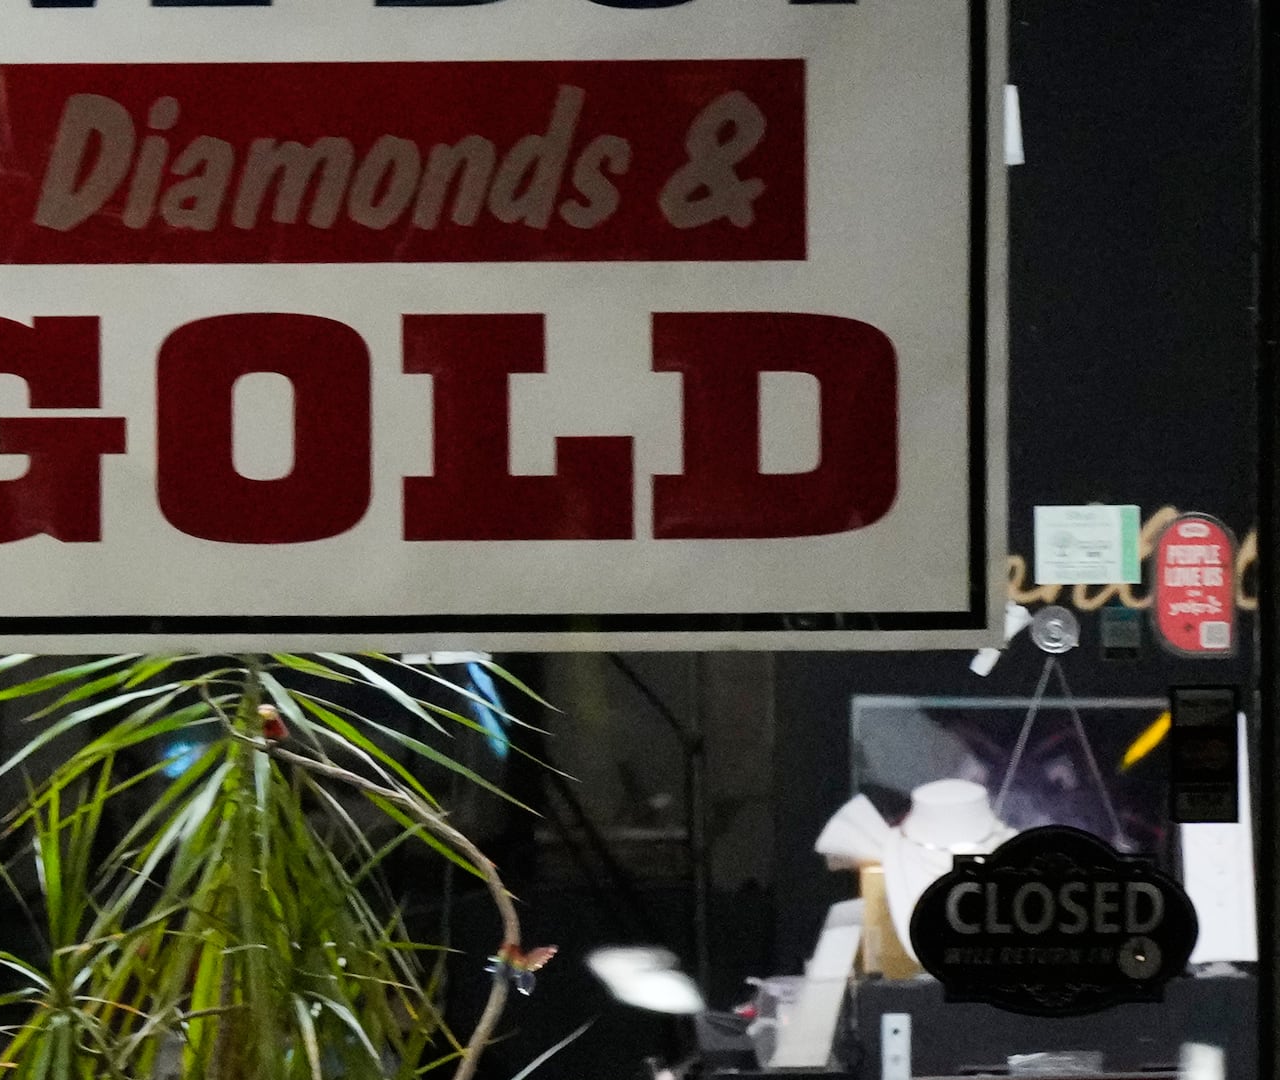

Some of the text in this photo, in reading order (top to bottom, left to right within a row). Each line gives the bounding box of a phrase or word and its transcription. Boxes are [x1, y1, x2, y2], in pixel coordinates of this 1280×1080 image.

[33, 84, 767, 234] Diamonds &
[1166, 544, 1222, 564] PEOPLE
[1165, 566, 1224, 587] LOVE US
[944, 880, 1166, 935] CLOSED
